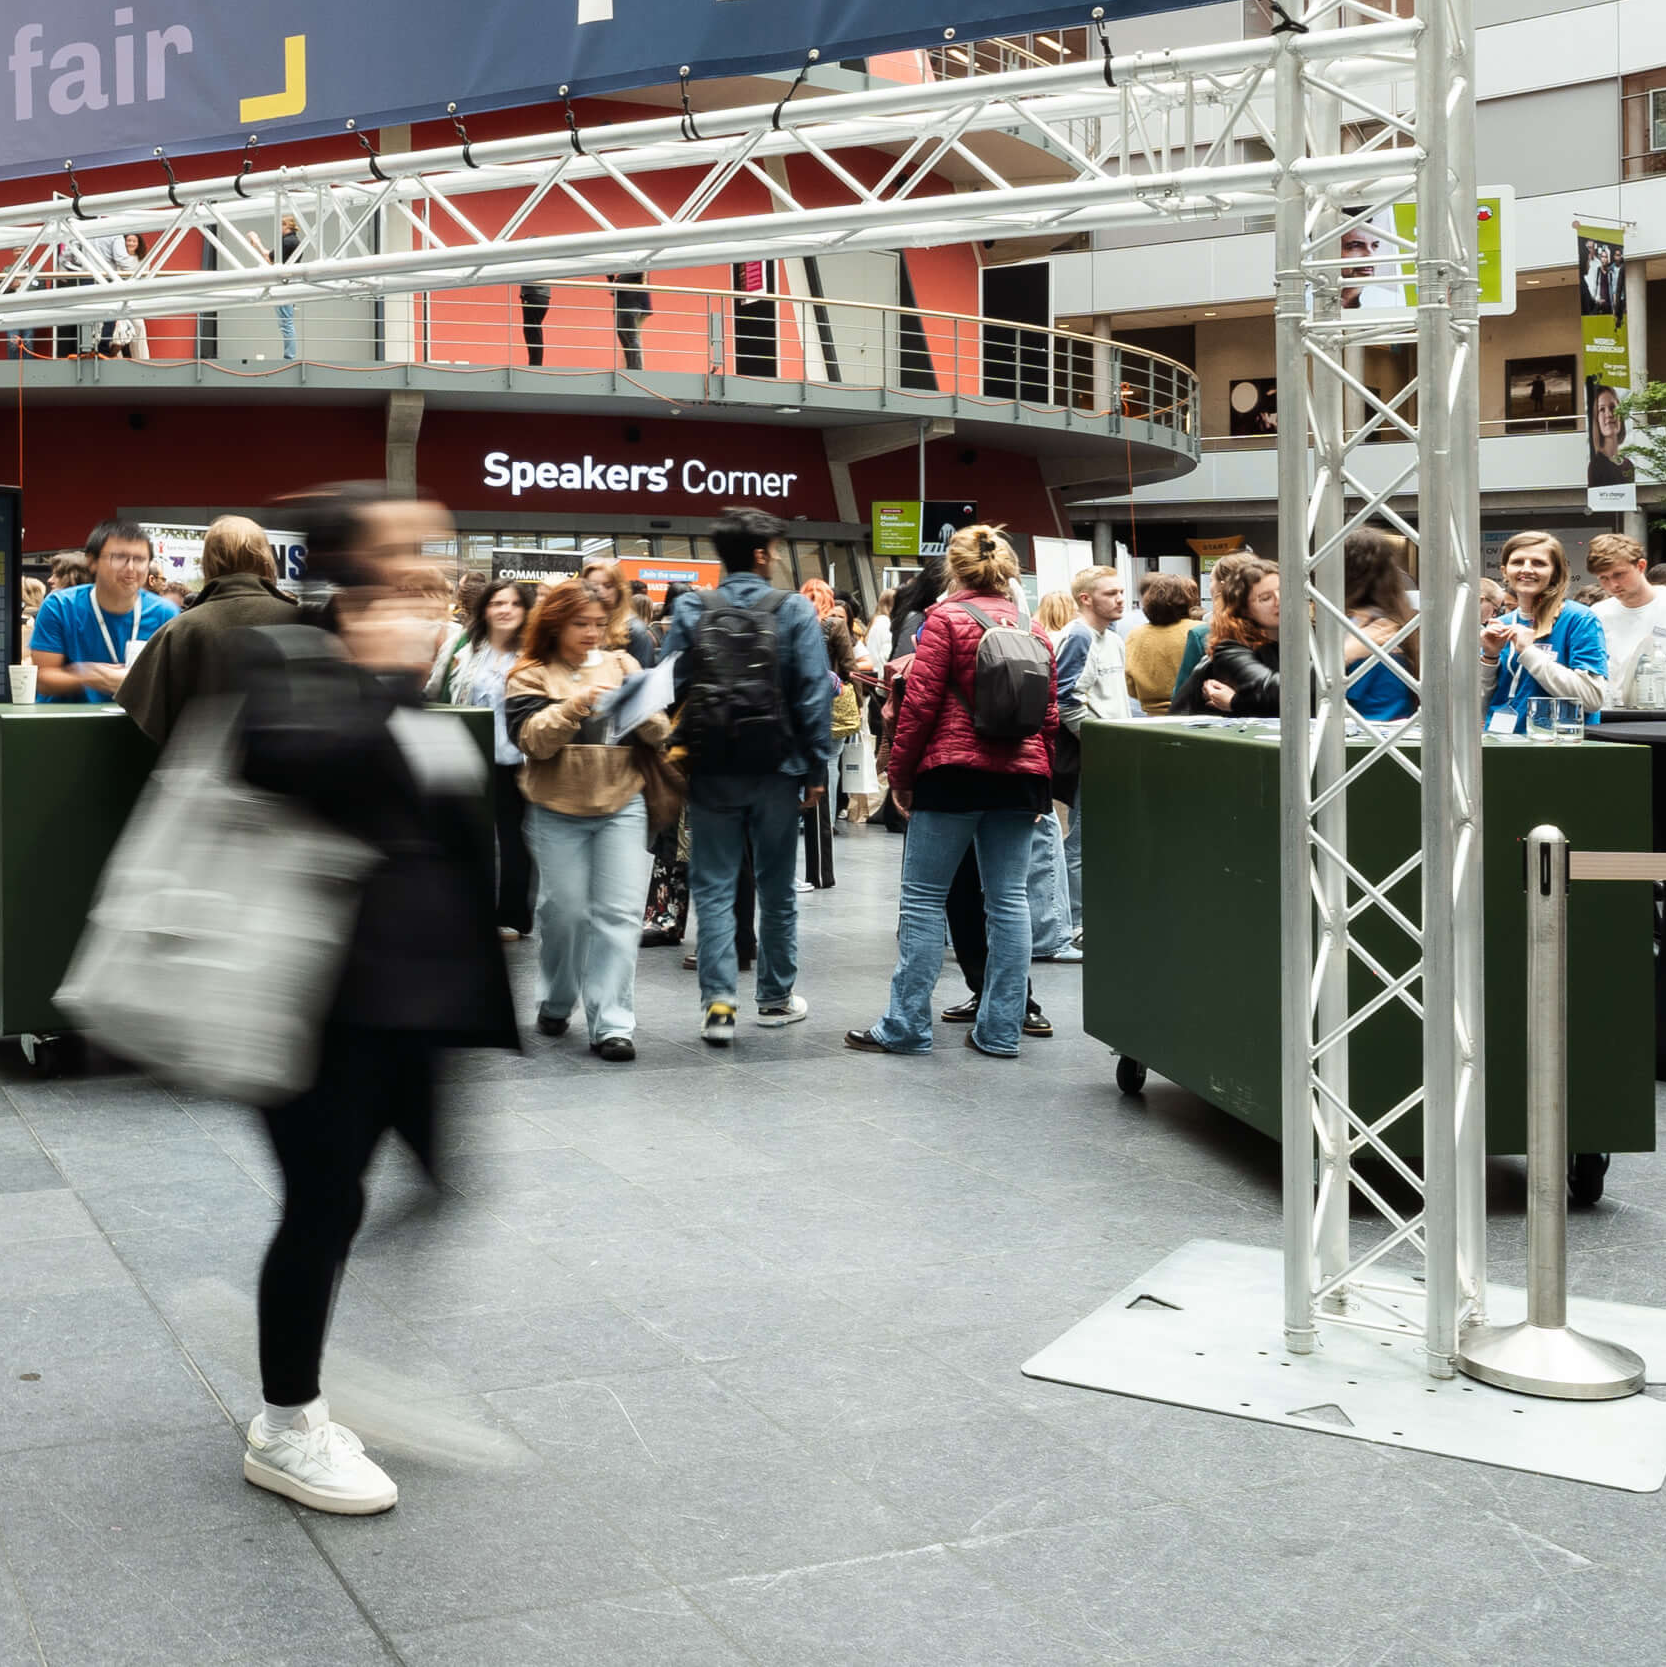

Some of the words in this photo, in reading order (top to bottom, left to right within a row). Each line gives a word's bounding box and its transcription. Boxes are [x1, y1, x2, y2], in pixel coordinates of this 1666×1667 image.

[8, 8, 194, 122] fair
[483, 451, 675, 496] Speakers'
[682, 459, 798, 497] Corner
[499, 568, 580, 581] COMMU
